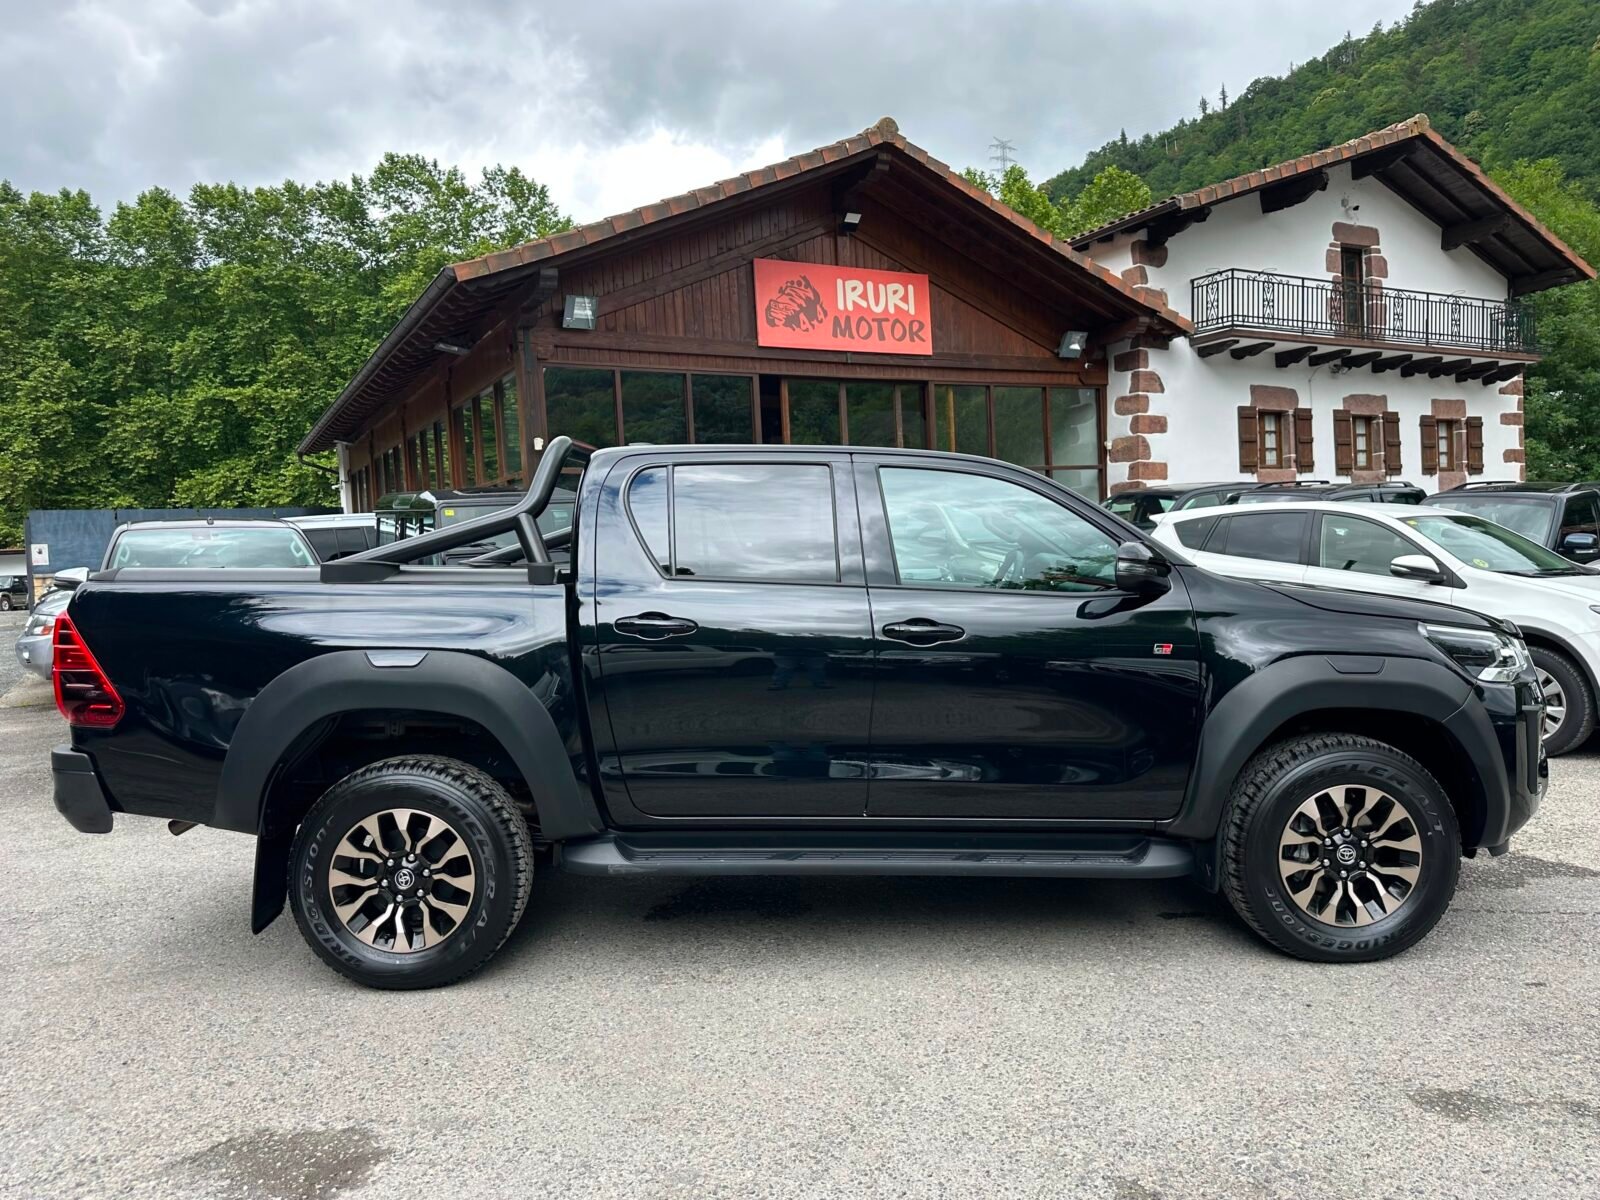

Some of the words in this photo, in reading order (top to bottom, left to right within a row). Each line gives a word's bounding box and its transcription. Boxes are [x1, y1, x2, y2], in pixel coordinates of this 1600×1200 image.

[836, 278, 915, 315] IRURI
[831, 315, 926, 342] MOTOR
[303, 815, 366, 969] BRIDGESTONE
